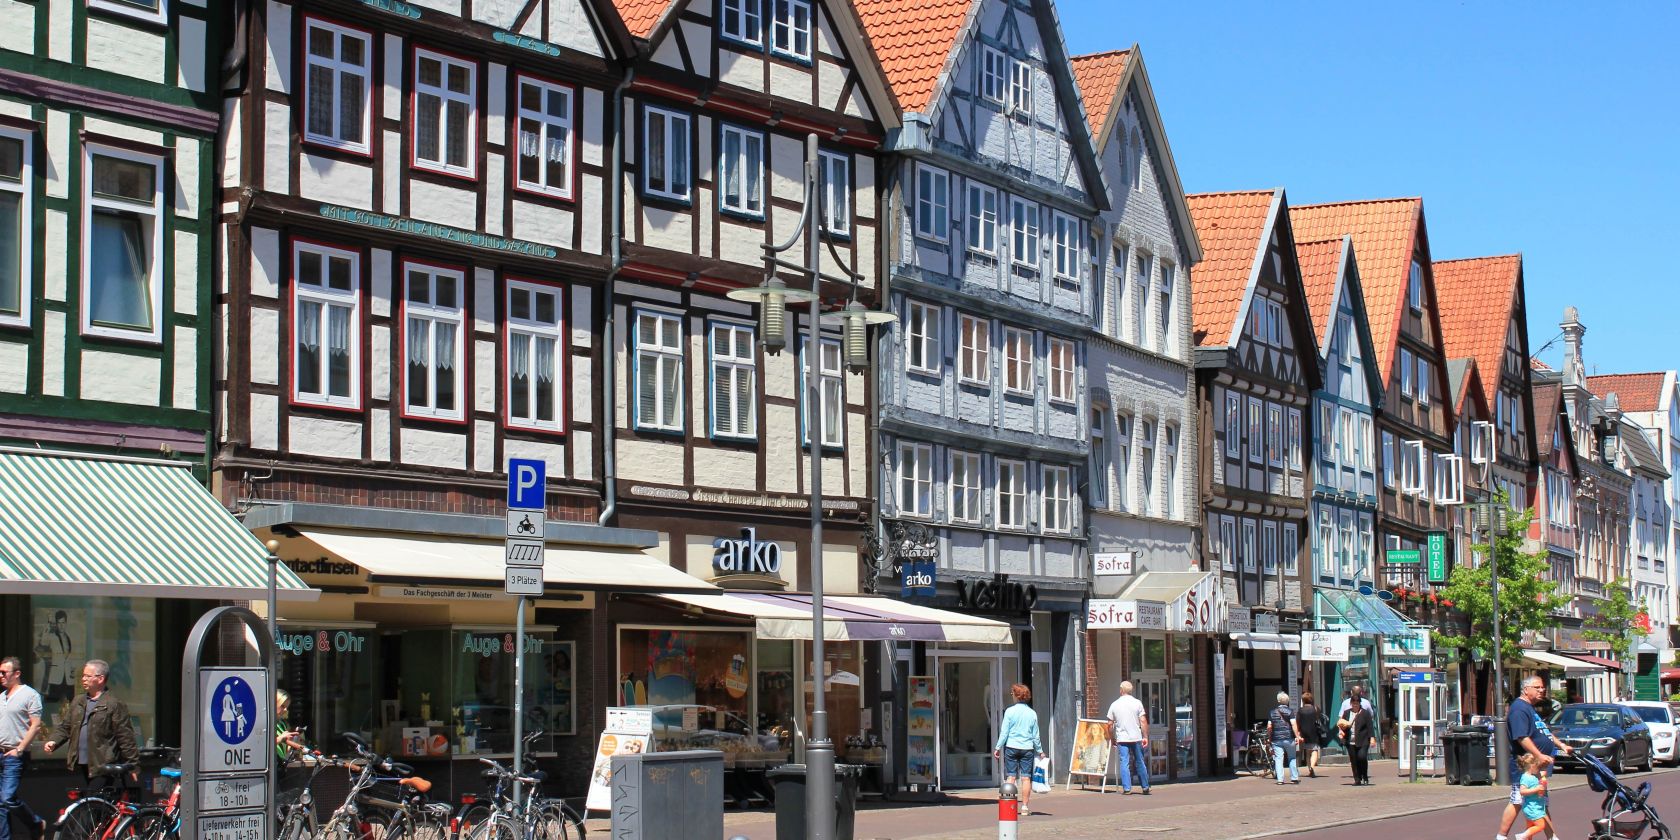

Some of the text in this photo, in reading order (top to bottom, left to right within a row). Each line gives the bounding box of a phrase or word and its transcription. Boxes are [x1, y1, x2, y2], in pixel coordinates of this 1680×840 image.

[516, 465, 537, 502] P
[719, 527, 781, 573] arko
[1431, 533, 1441, 579] HOTEL
[1097, 556, 1131, 571] Sofra
[511, 576, 538, 585] 3 Plätze
[906, 571, 932, 586] arko
[403, 589, 415, 597] Das
[416, 589, 455, 598] Fachgeschäft
[1184, 576, 1222, 627] Sof
[1088, 604, 1135, 625] Sofra
[1139, 605, 1163, 616] RESTAURANT
[274, 629, 364, 656] Auge & Ohr
[462, 632, 500, 657] Auge
[503, 633, 514, 653] &
[224, 749, 251, 766] ONE
[235, 781, 250, 792] frei
[202, 817, 260, 832] Lieferverkehr frei
